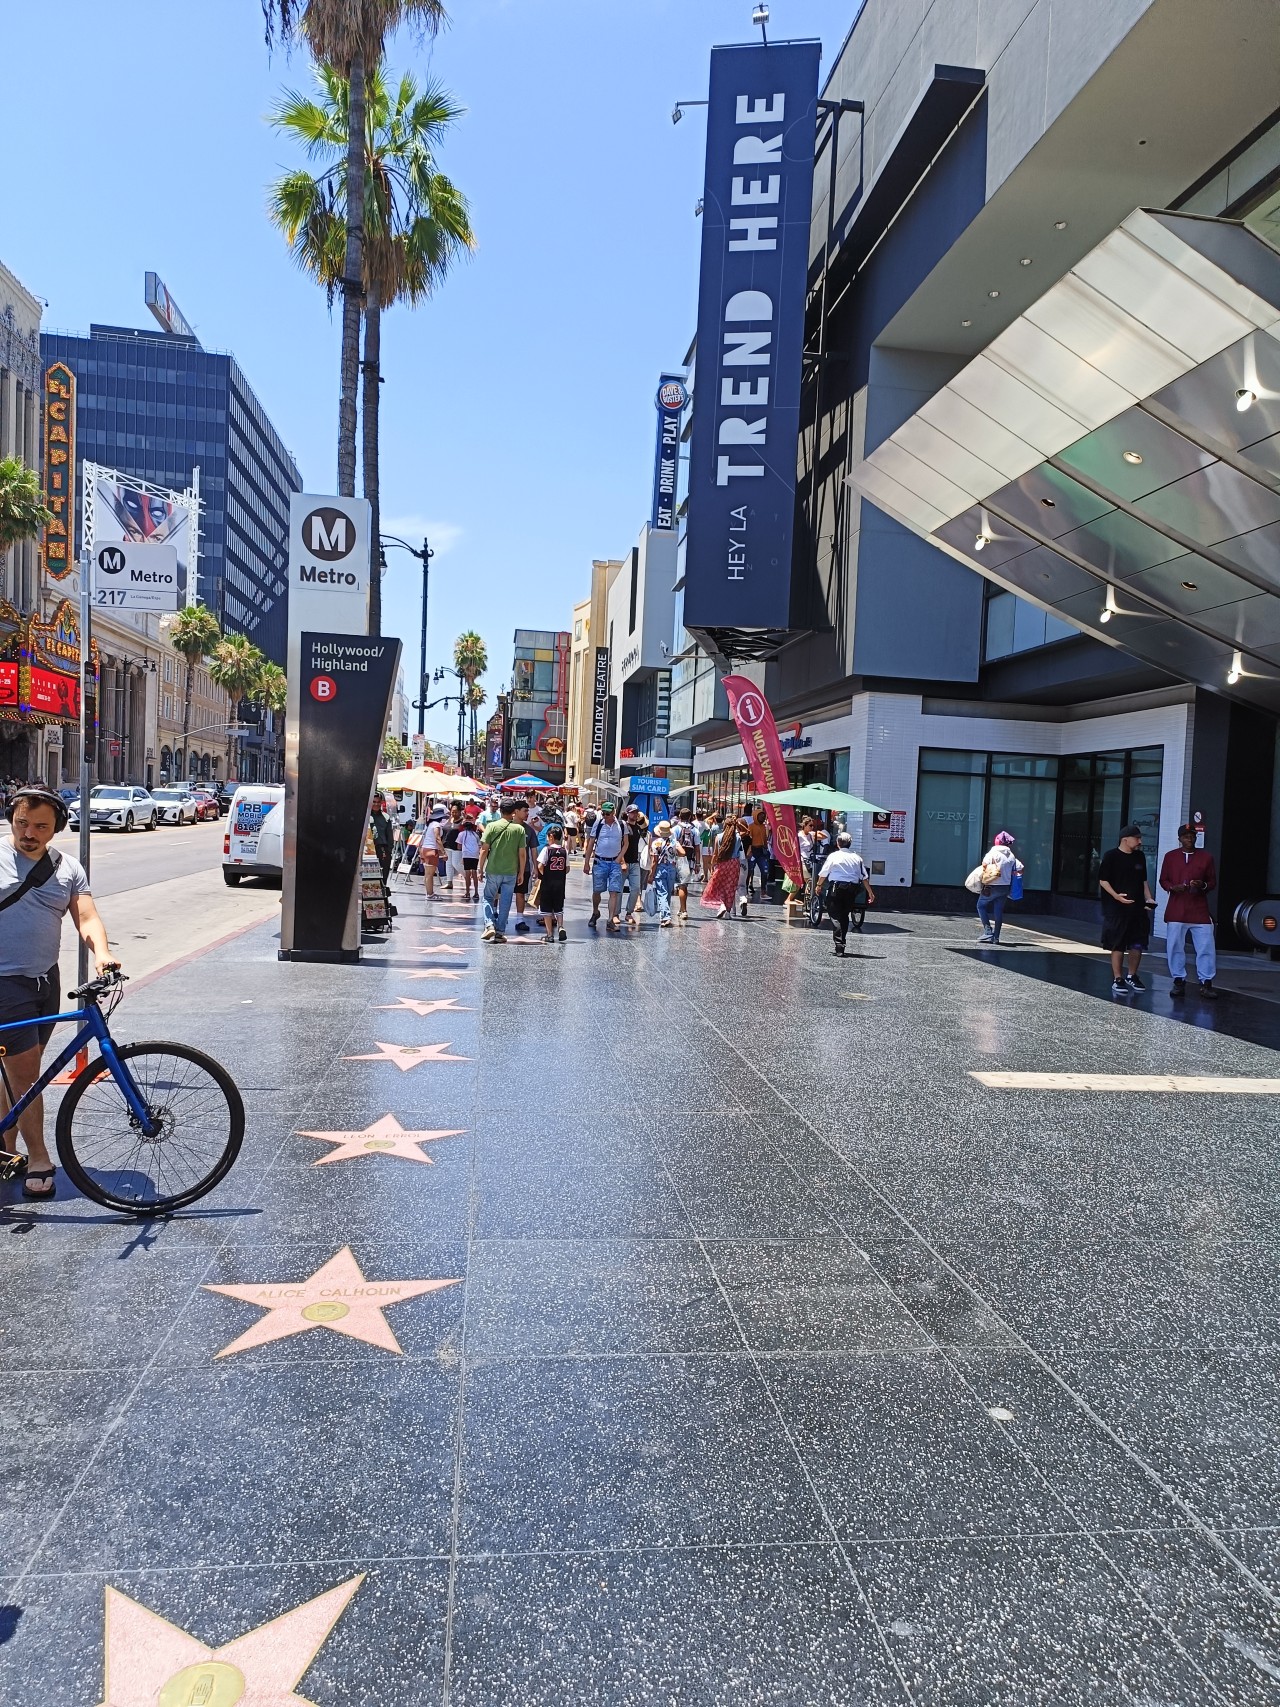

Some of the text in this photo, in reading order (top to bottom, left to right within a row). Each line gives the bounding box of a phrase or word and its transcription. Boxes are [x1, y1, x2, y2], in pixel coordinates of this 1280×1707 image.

[728, 92, 786, 252] HERE
[48, 380, 70, 400] EL
[716, 289, 775, 486] TREND
[49, 401, 68, 560] CAPITAN
[658, 416, 678, 528] EAT DRINK PLAY
[730, 506, 747, 531] LA
[311, 516, 346, 553] M
[103, 552, 120, 570] M
[728, 538, 746, 580] HEY
[130, 570, 173, 584] Metro
[300, 565, 356, 586] Metro
[97, 590, 126, 605] 217
[311, 642, 384, 658] Hollywood/
[311, 658, 368, 672] Highland
[317, 681, 330, 696] B
[594, 653, 607, 744] DOLBY THEATRE
[752, 729, 784, 821] INRMATION
[244, 804, 262, 812] RB
[926, 810, 977, 822] VERVE
[550, 856, 565, 871] 23
[257, 1286, 401, 1298] ALICE CALHOUN
